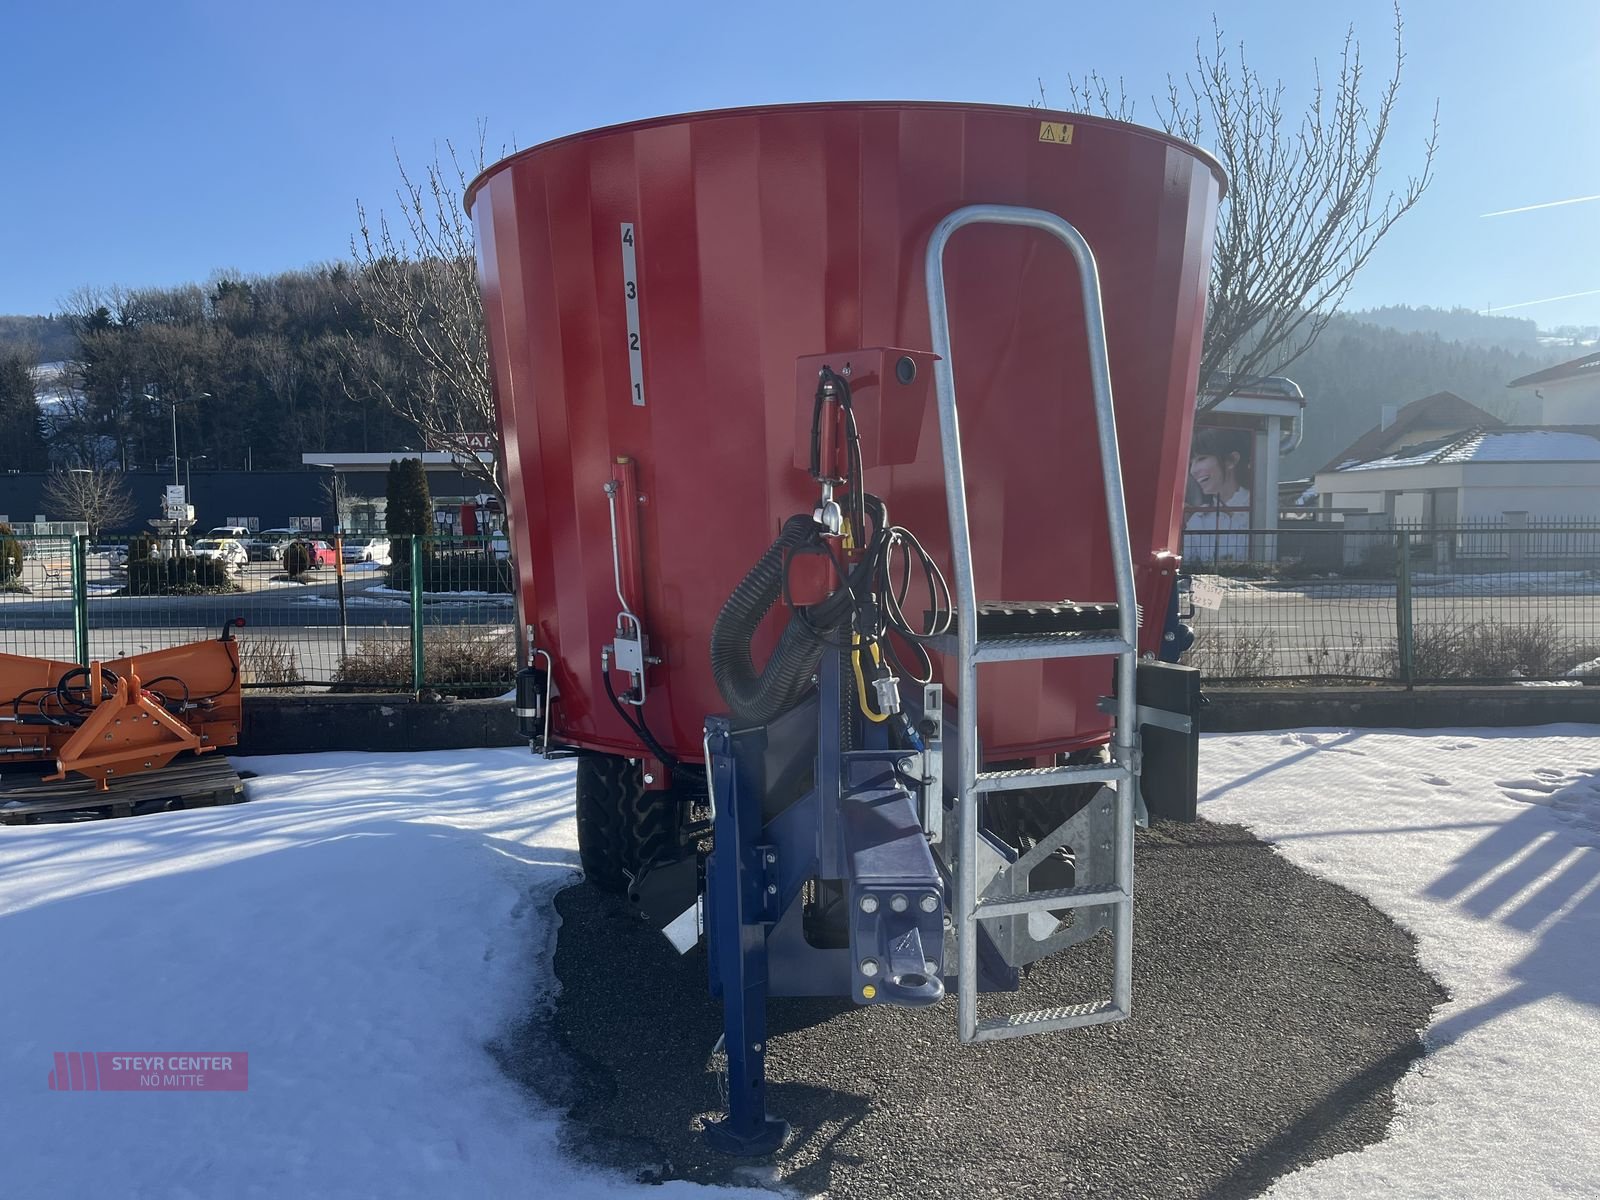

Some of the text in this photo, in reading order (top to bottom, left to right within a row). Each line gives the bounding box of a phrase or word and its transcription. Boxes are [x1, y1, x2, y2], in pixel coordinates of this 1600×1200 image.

[623, 228, 633, 247] 4
[626, 281, 636, 300] 3
[629, 333, 639, 351] 2
[634, 383, 641, 400] 1
[929, 690, 936, 708] 1
